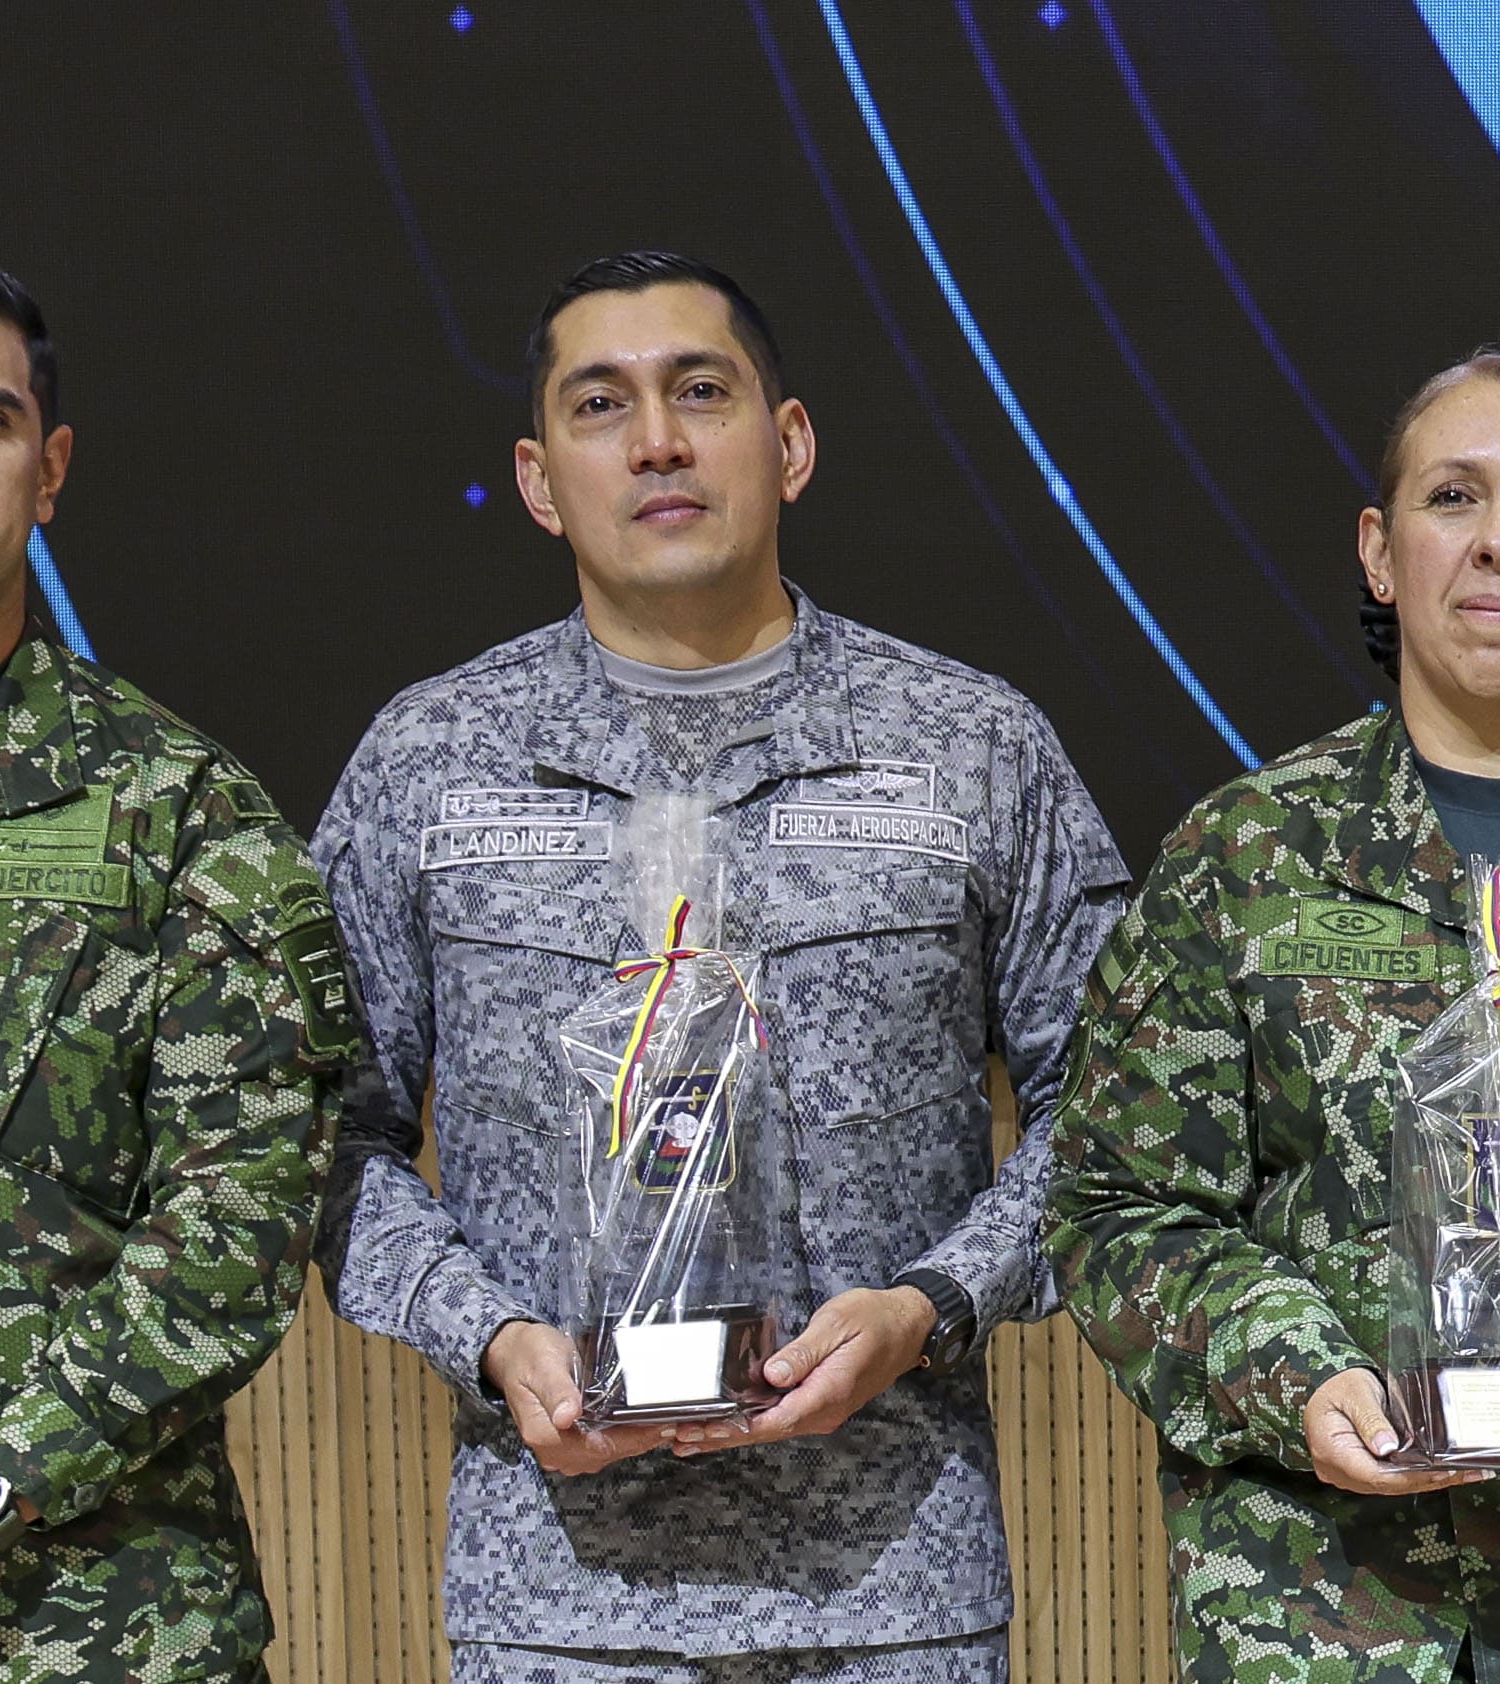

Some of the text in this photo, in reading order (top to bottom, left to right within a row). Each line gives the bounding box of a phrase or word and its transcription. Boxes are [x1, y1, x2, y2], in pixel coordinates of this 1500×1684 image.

[450, 831, 578, 856] LANDINEZ
[779, 813, 962, 851] FUERZA AEROESPACIAL
[1336, 914, 1366, 931] SC
[1274, 941, 1422, 975] CIFUENTES
